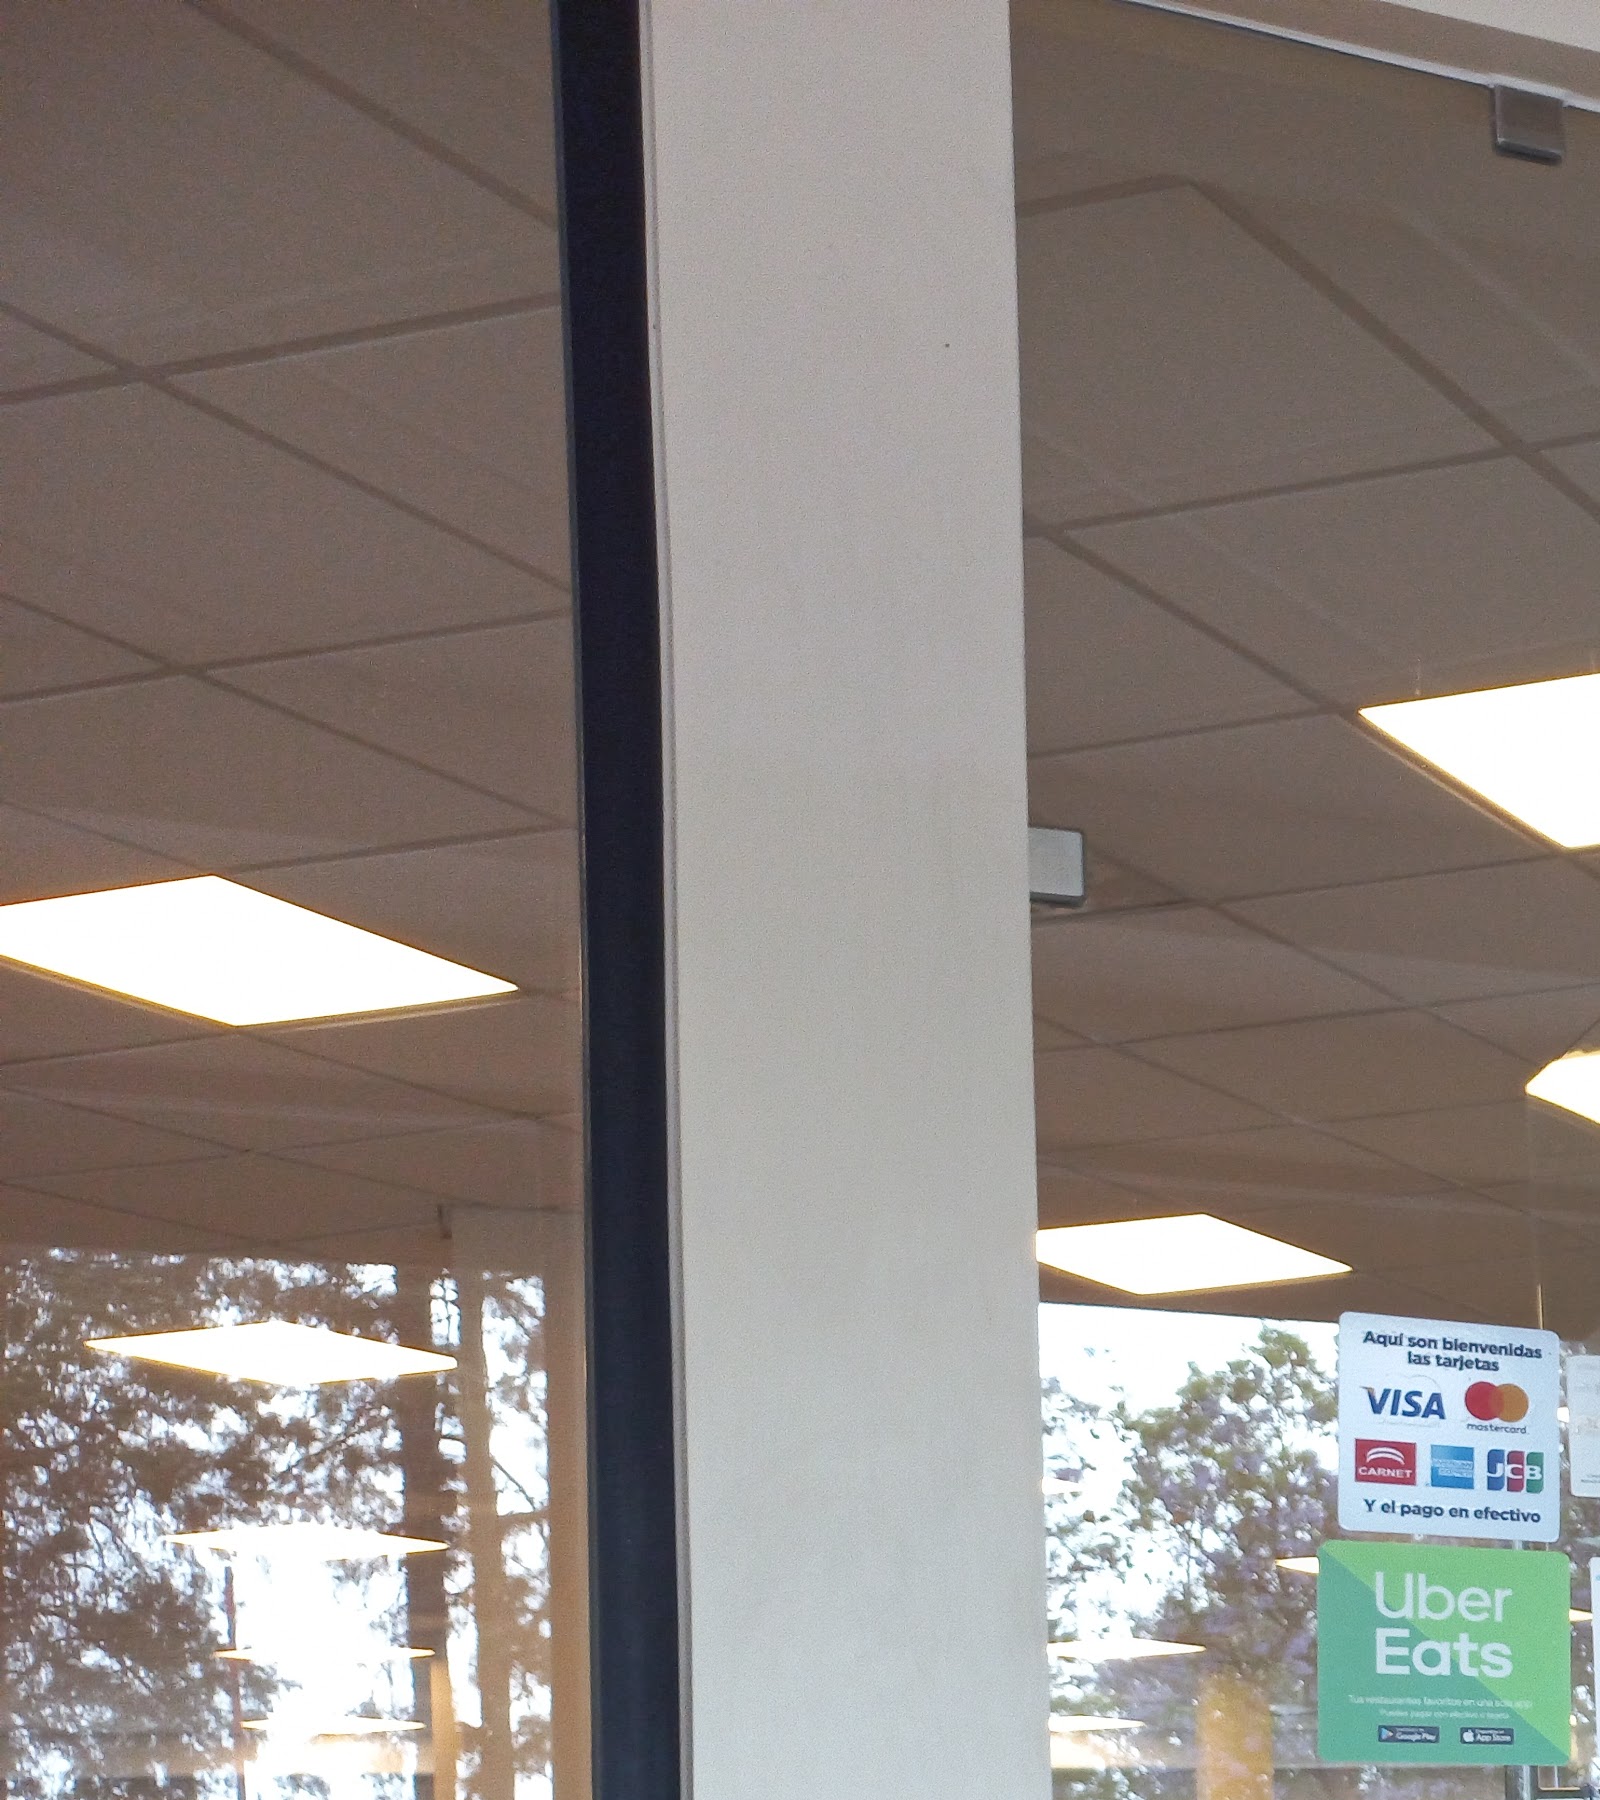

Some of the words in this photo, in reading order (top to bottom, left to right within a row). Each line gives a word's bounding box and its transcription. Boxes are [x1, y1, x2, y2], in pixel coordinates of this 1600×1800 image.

[1363, 1331, 1403, 1347] Aquí
[1408, 1337, 1438, 1349] son
[1442, 1337, 1542, 1359] bienvenidas
[1408, 1351, 1431, 1365] las
[1436, 1355, 1499, 1371] tarjetas
[1360, 1386, 1446, 1419] VISA
[1466, 1423, 1527, 1434] mastercard
[1358, 1466, 1412, 1479] CARNET
[1487, 1463, 1543, 1480] JCB
[1364, 1499, 1376, 1512] Y
[1382, 1500, 1395, 1513] el
[1401, 1504, 1444, 1518] pago
[1449, 1506, 1469, 1518] en
[1474, 1507, 1541, 1523] efectivo
[1375, 1571, 1513, 1622] Uber
[1375, 1627, 1514, 1679] Eats
[1396, 1732, 1422, 1742] Google
[1422, 1733, 1436, 1741] Play
[1476, 1734, 1491, 1742] App
[1492, 1734, 1511, 1742] Store
